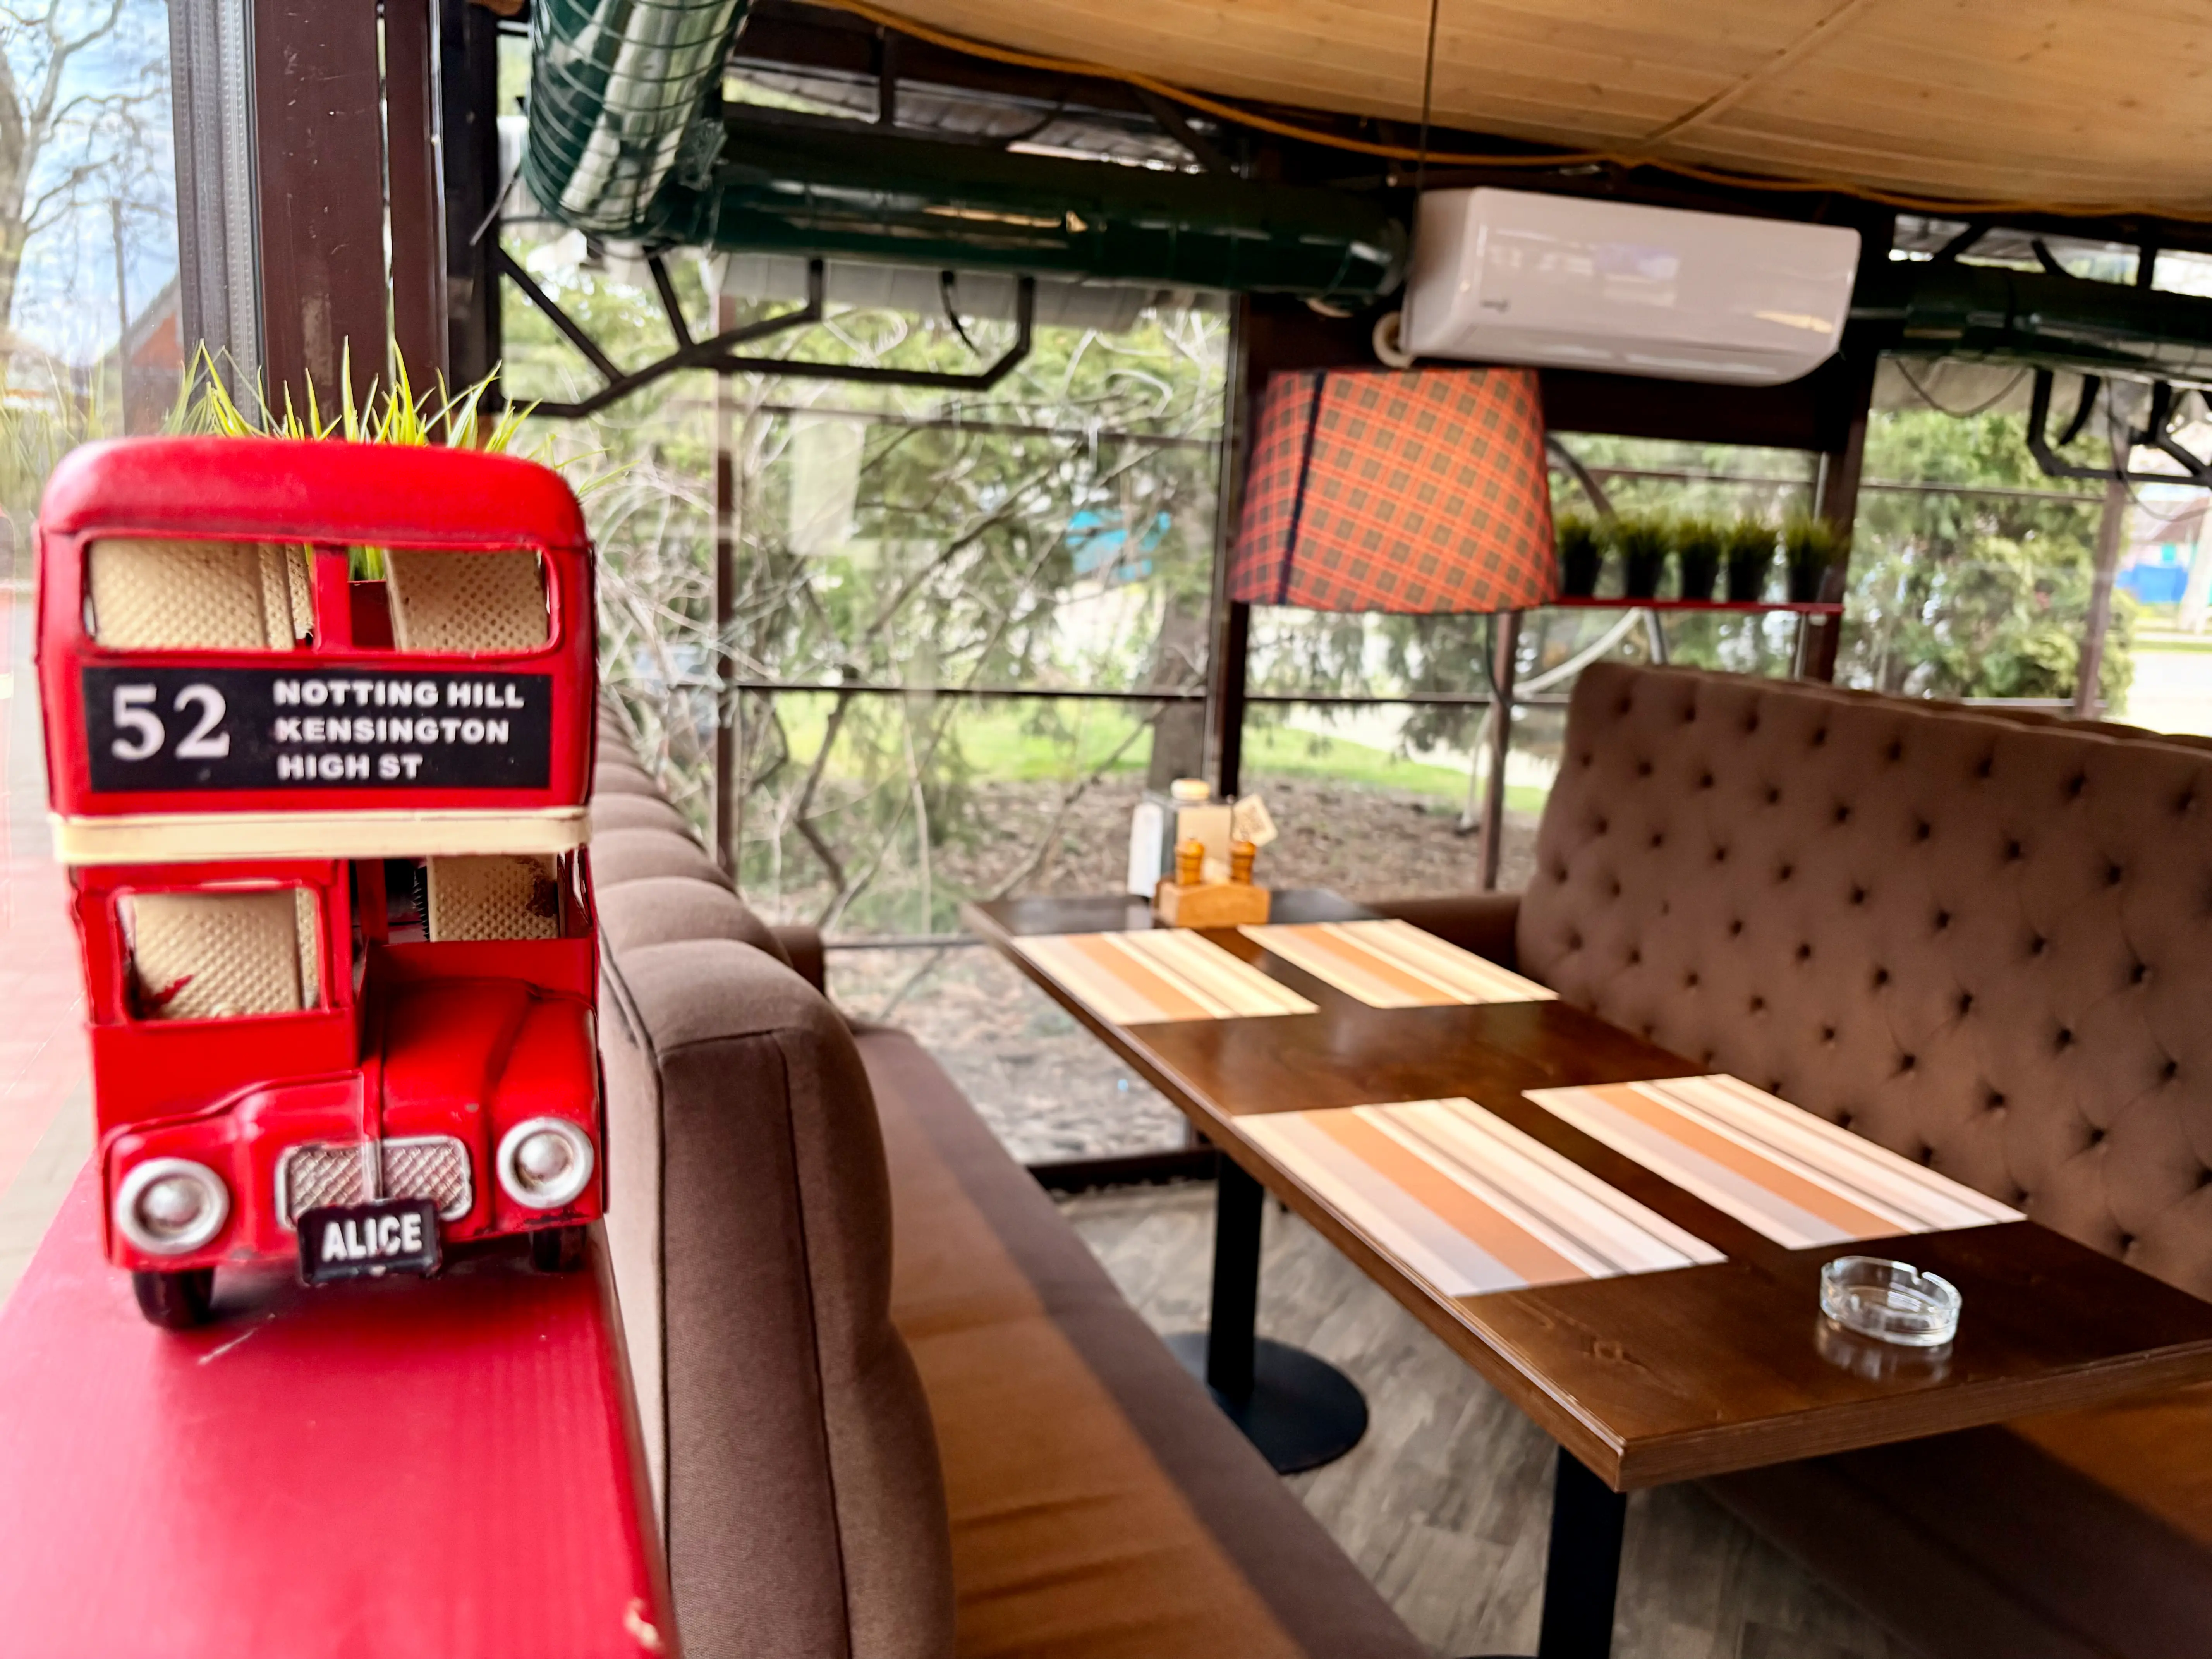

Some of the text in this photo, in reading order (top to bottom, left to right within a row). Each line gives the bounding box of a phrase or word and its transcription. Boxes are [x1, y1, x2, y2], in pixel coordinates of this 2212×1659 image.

[273, 680, 524, 708] NOTTING HILL
[112, 684, 230, 760] 52
[275, 718, 509, 744] KENSINGTON
[277, 754, 423, 779] HIGH ST
[321, 1212, 422, 1262] ALICE
